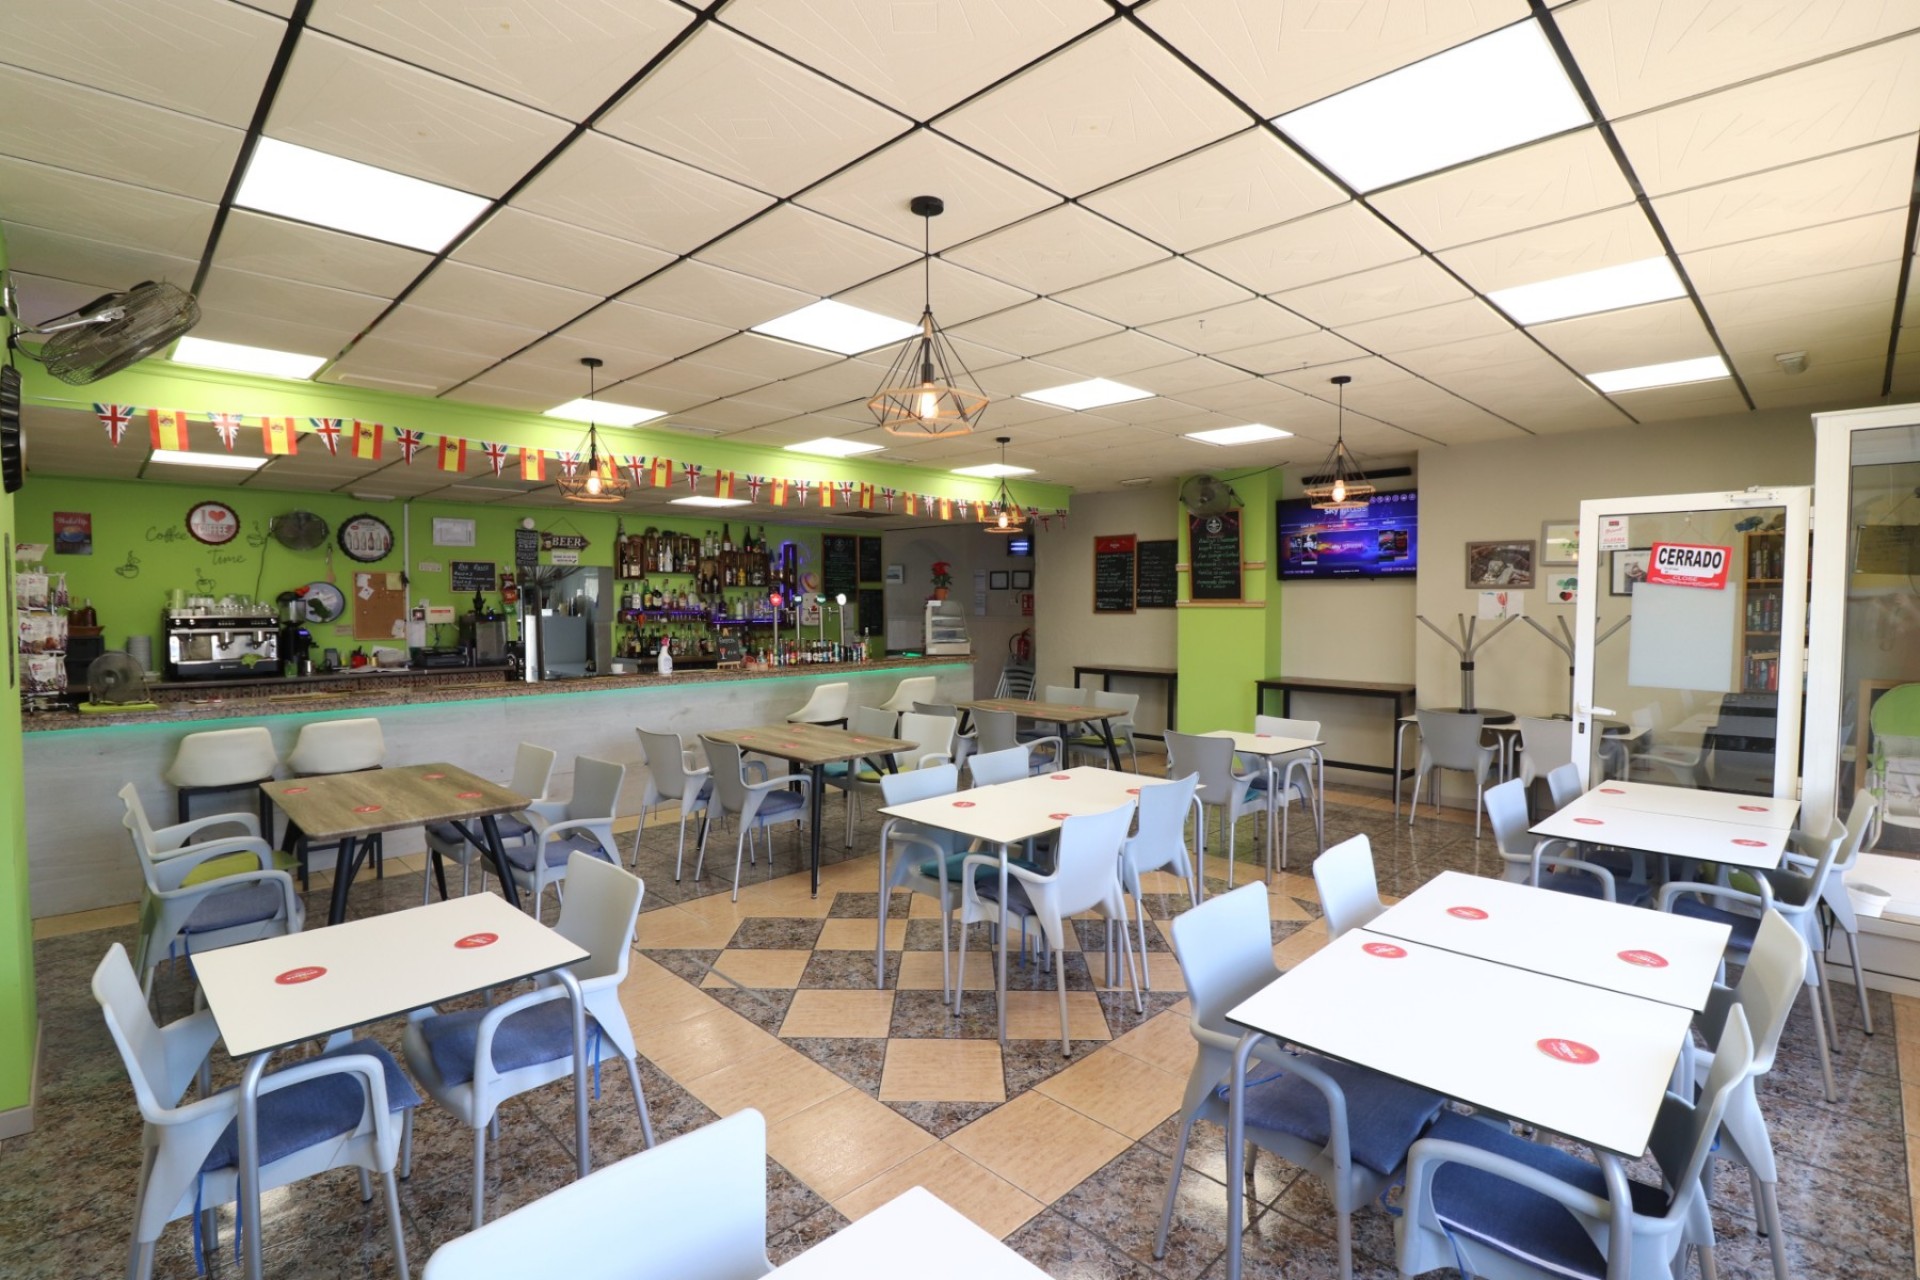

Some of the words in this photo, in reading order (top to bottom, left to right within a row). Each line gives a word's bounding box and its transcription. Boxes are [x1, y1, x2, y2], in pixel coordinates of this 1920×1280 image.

[200, 509, 206, 523] I
[145, 525, 188, 543] Coffee
[197, 525, 229, 535] COFFEE
[552, 536, 581, 546] BEER
[207, 549, 247, 565] Time
[1659, 548, 1722, 569] CERRADO
